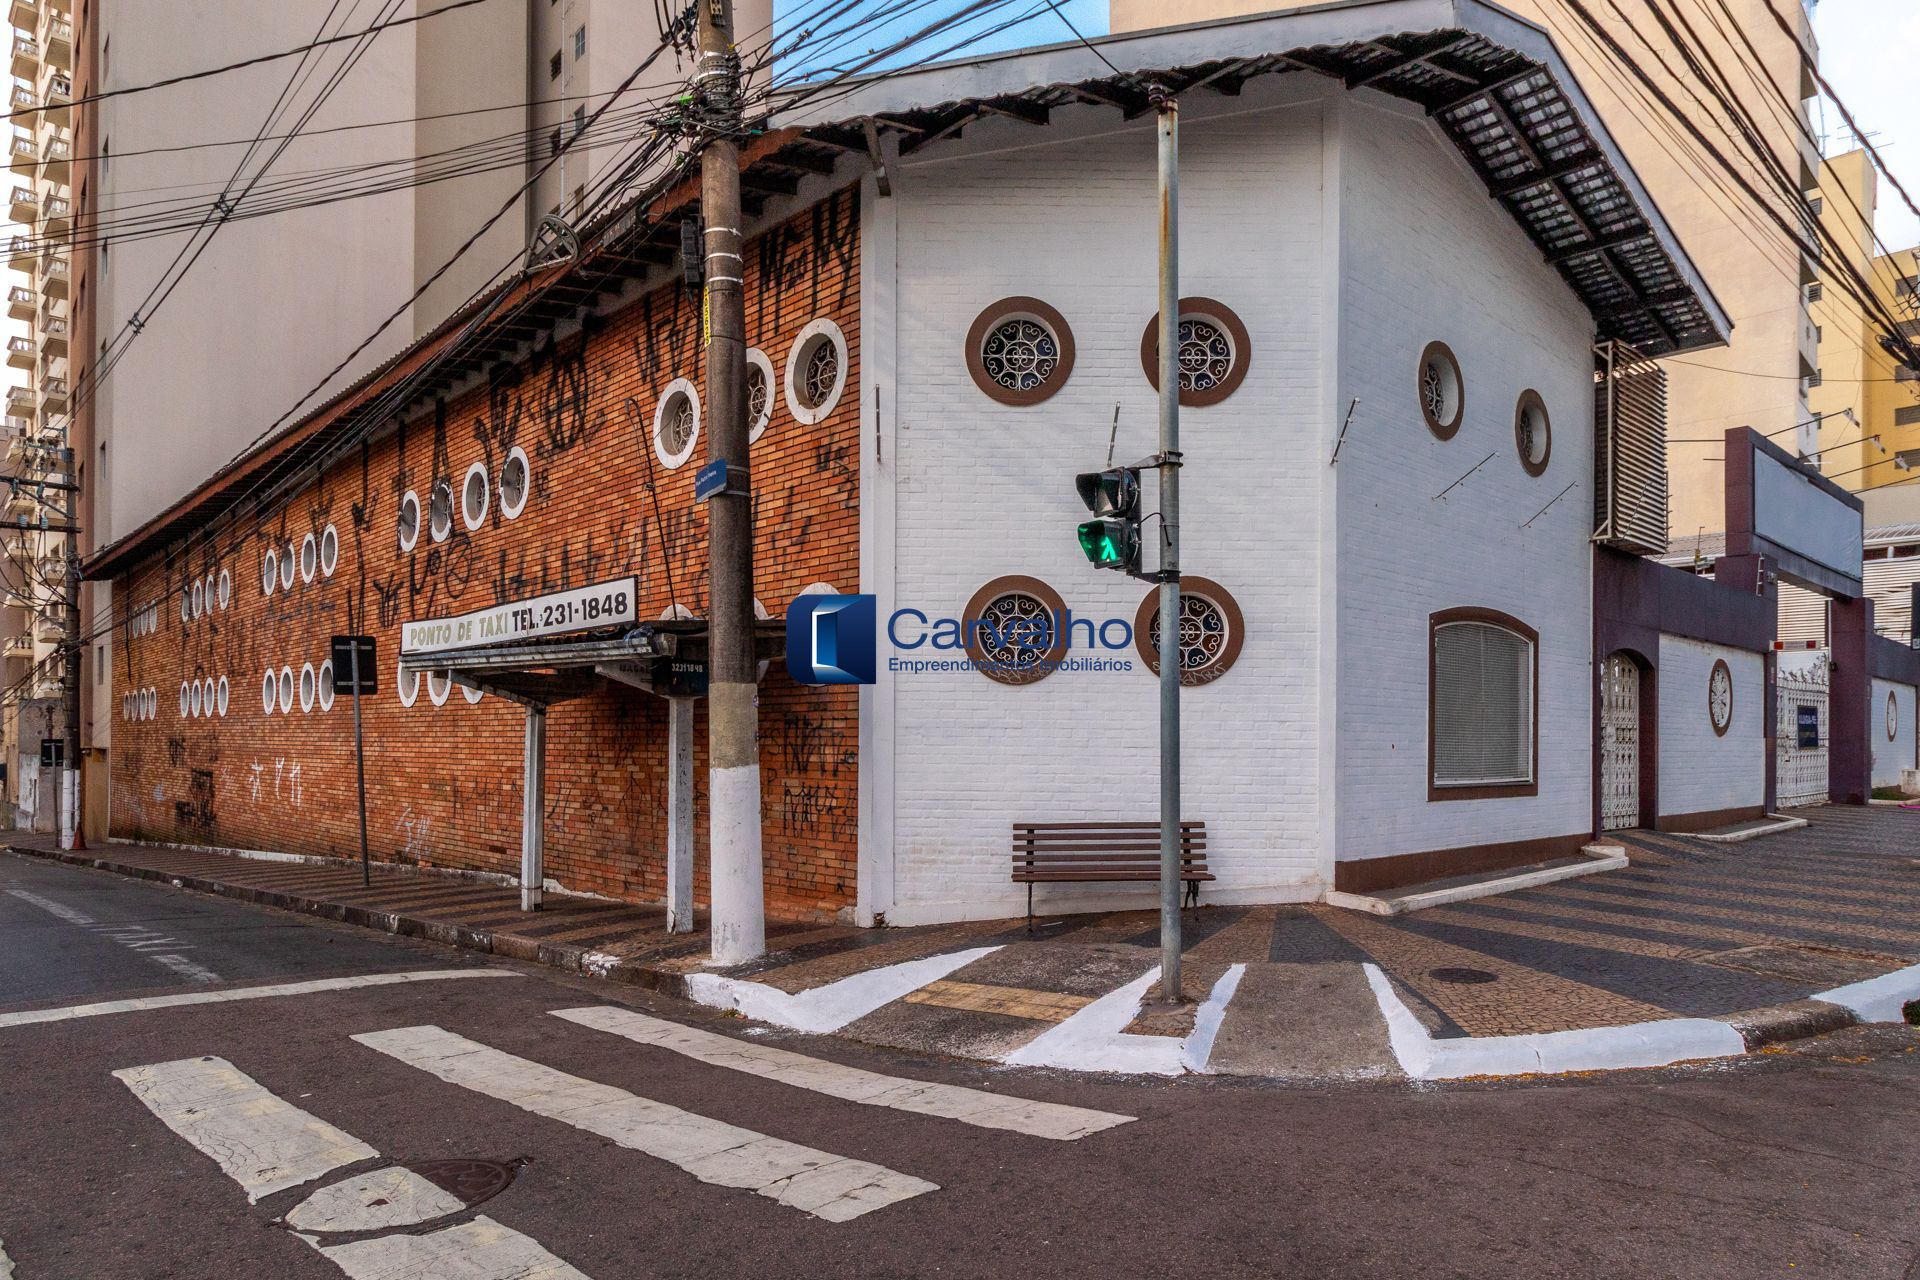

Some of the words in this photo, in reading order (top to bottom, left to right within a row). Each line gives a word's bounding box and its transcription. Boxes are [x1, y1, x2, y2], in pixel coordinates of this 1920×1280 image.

[410, 624, 452, 646] PONTO
[457, 620, 473, 642] DE
[479, 612, 508, 638] TAXI
